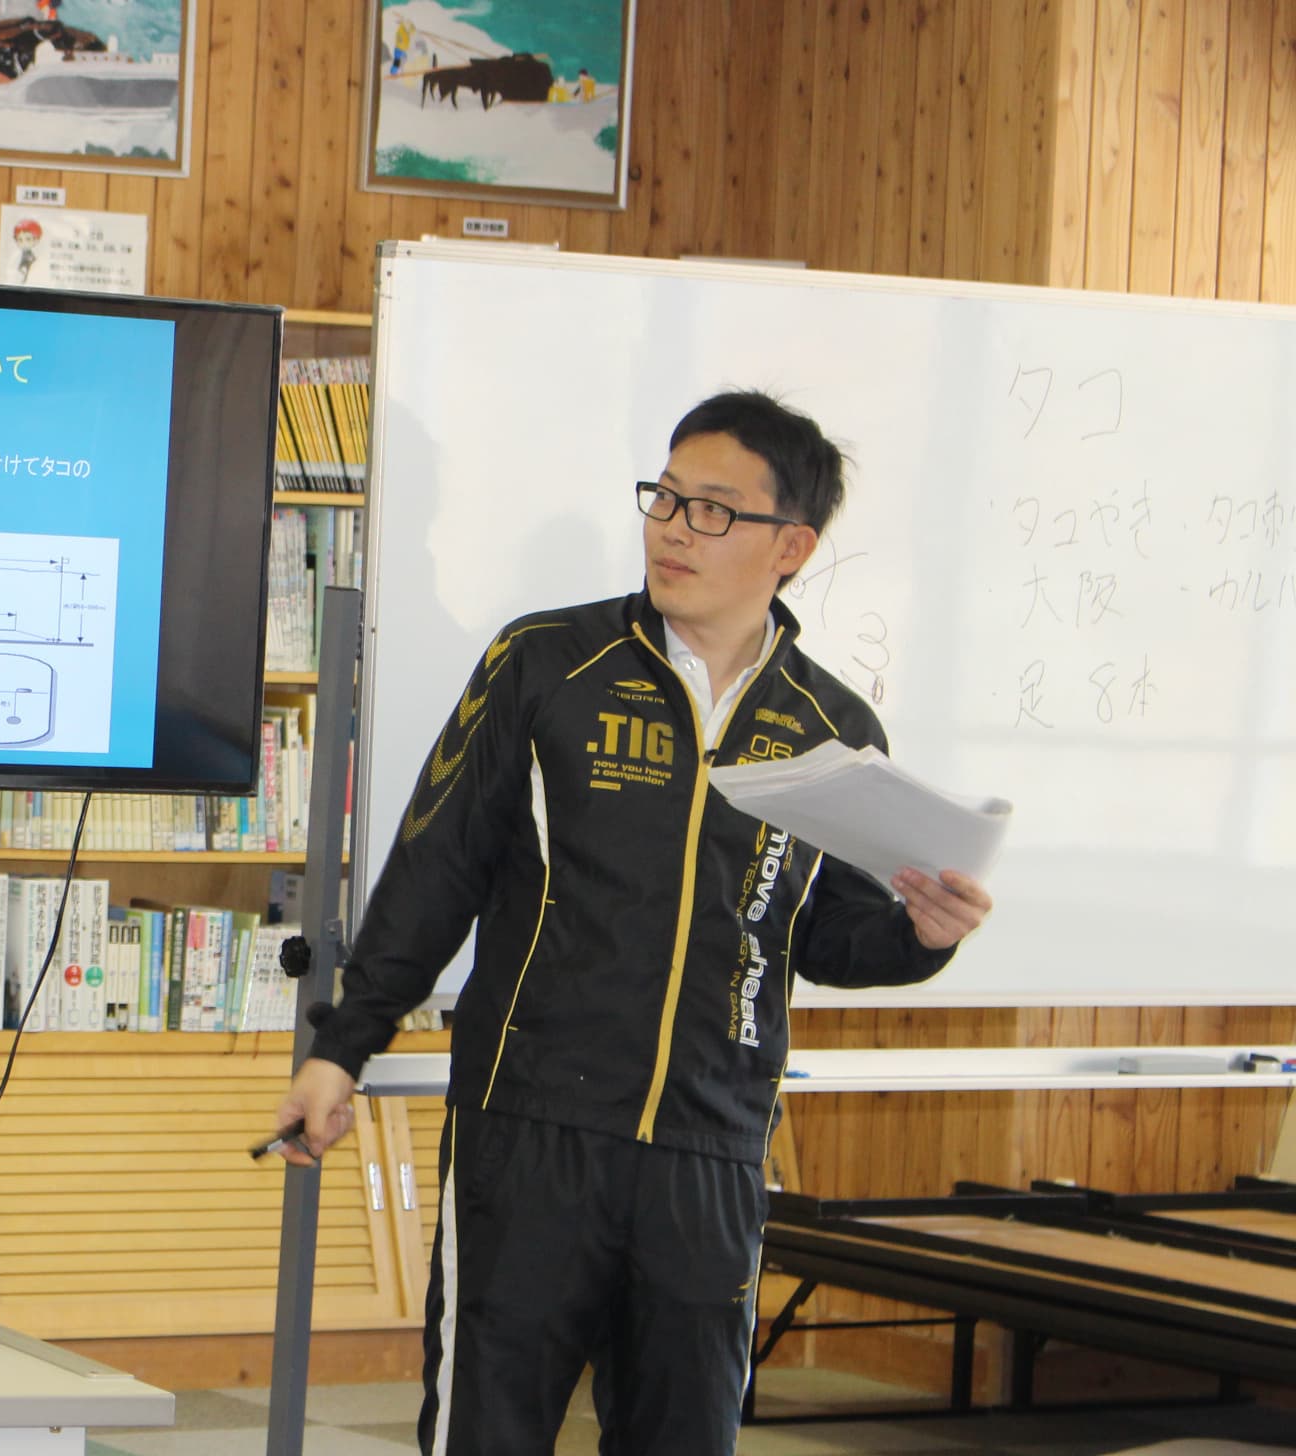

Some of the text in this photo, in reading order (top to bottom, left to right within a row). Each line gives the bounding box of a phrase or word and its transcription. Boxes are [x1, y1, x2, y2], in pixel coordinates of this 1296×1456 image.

[1007, 362, 1123, 441] タコ
[1020, 564, 1125, 629] 大阪
[592, 768, 600, 776] a
[603, 769, 665, 786] companion
[593, 760, 672, 780] now you have
[730, 970, 742, 988] IN
[739, 932, 768, 1048] ahead
[727, 991, 739, 1042] GAME
